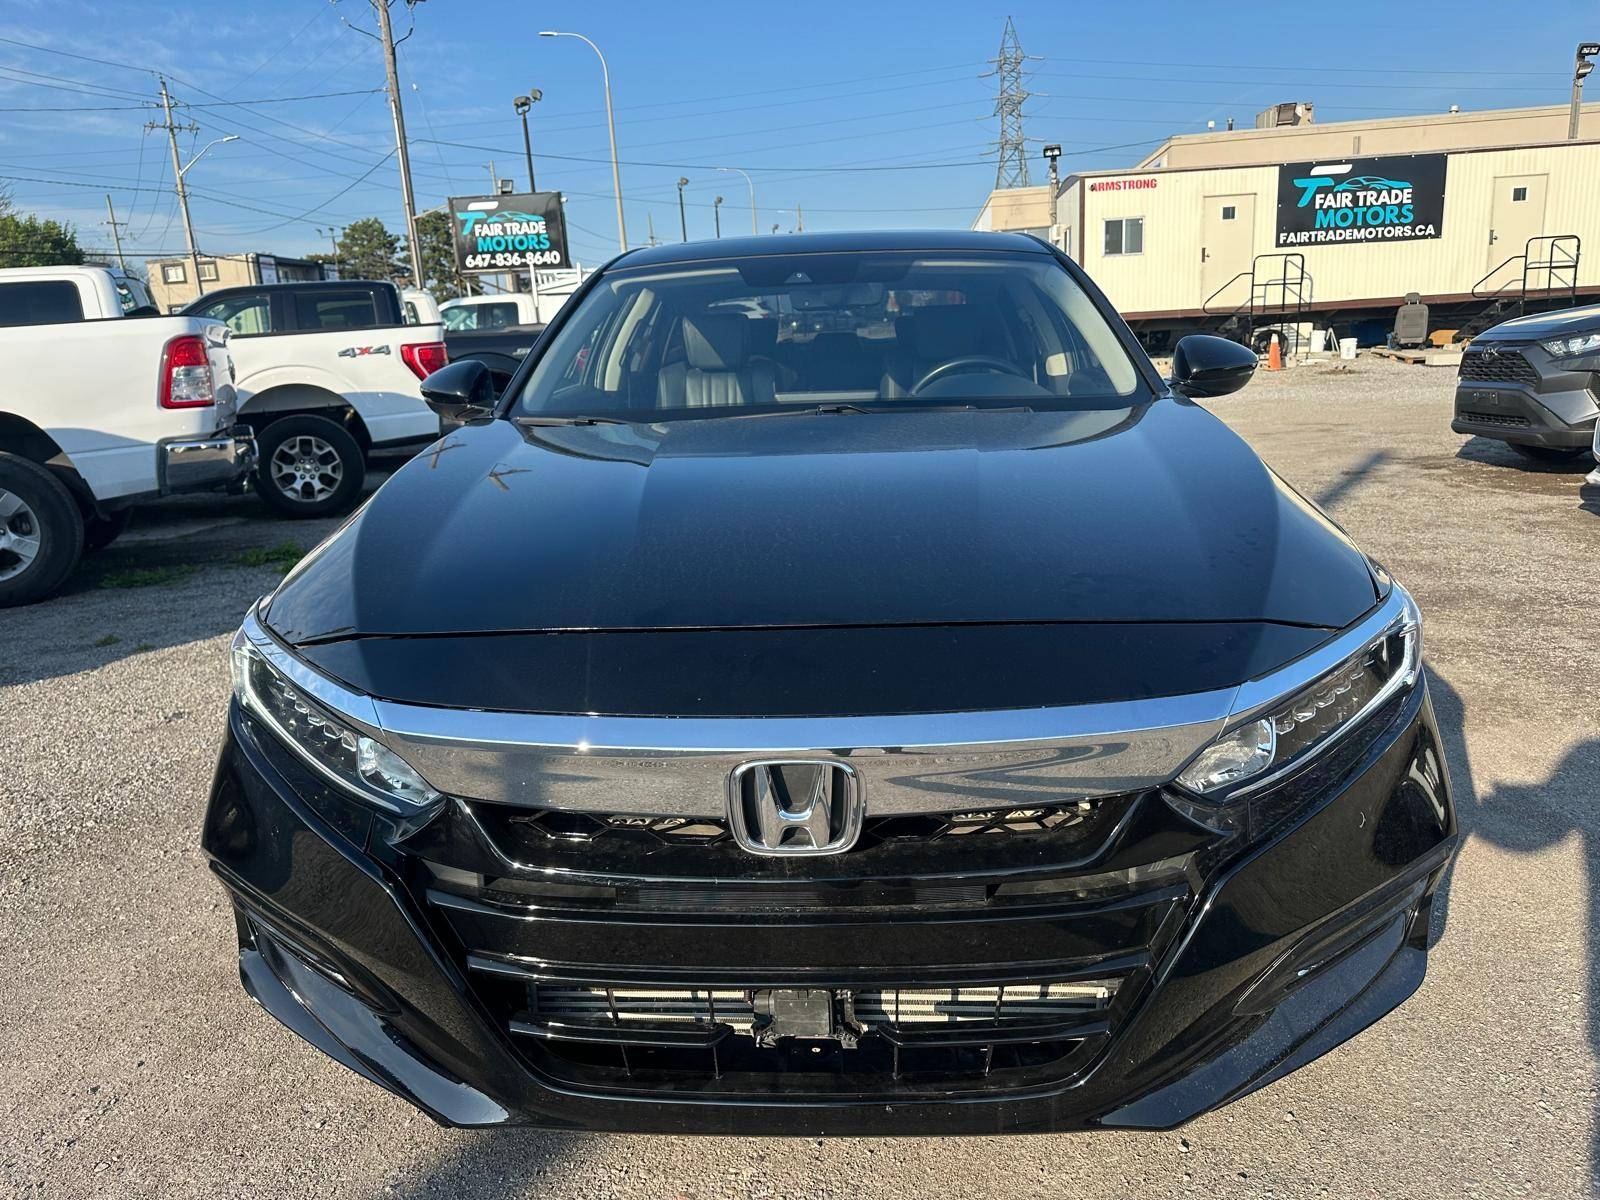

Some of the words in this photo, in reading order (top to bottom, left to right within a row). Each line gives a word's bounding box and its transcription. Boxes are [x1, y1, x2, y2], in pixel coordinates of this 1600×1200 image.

[1090, 178, 1157, 192] ARMSTRONG
[1315, 192, 1353, 209] FAIR
[1356, 188, 1413, 208] TRADE
[1314, 204, 1414, 229] MOTORS
[474, 223, 504, 237] FAIR
[504, 221, 547, 235] TRADE
[1279, 224, 1435, 244] FAIRTRADEMOTORS.CA
[477, 234, 550, 252] MOTORS
[465, 251, 560, 268] 647-836-8640
